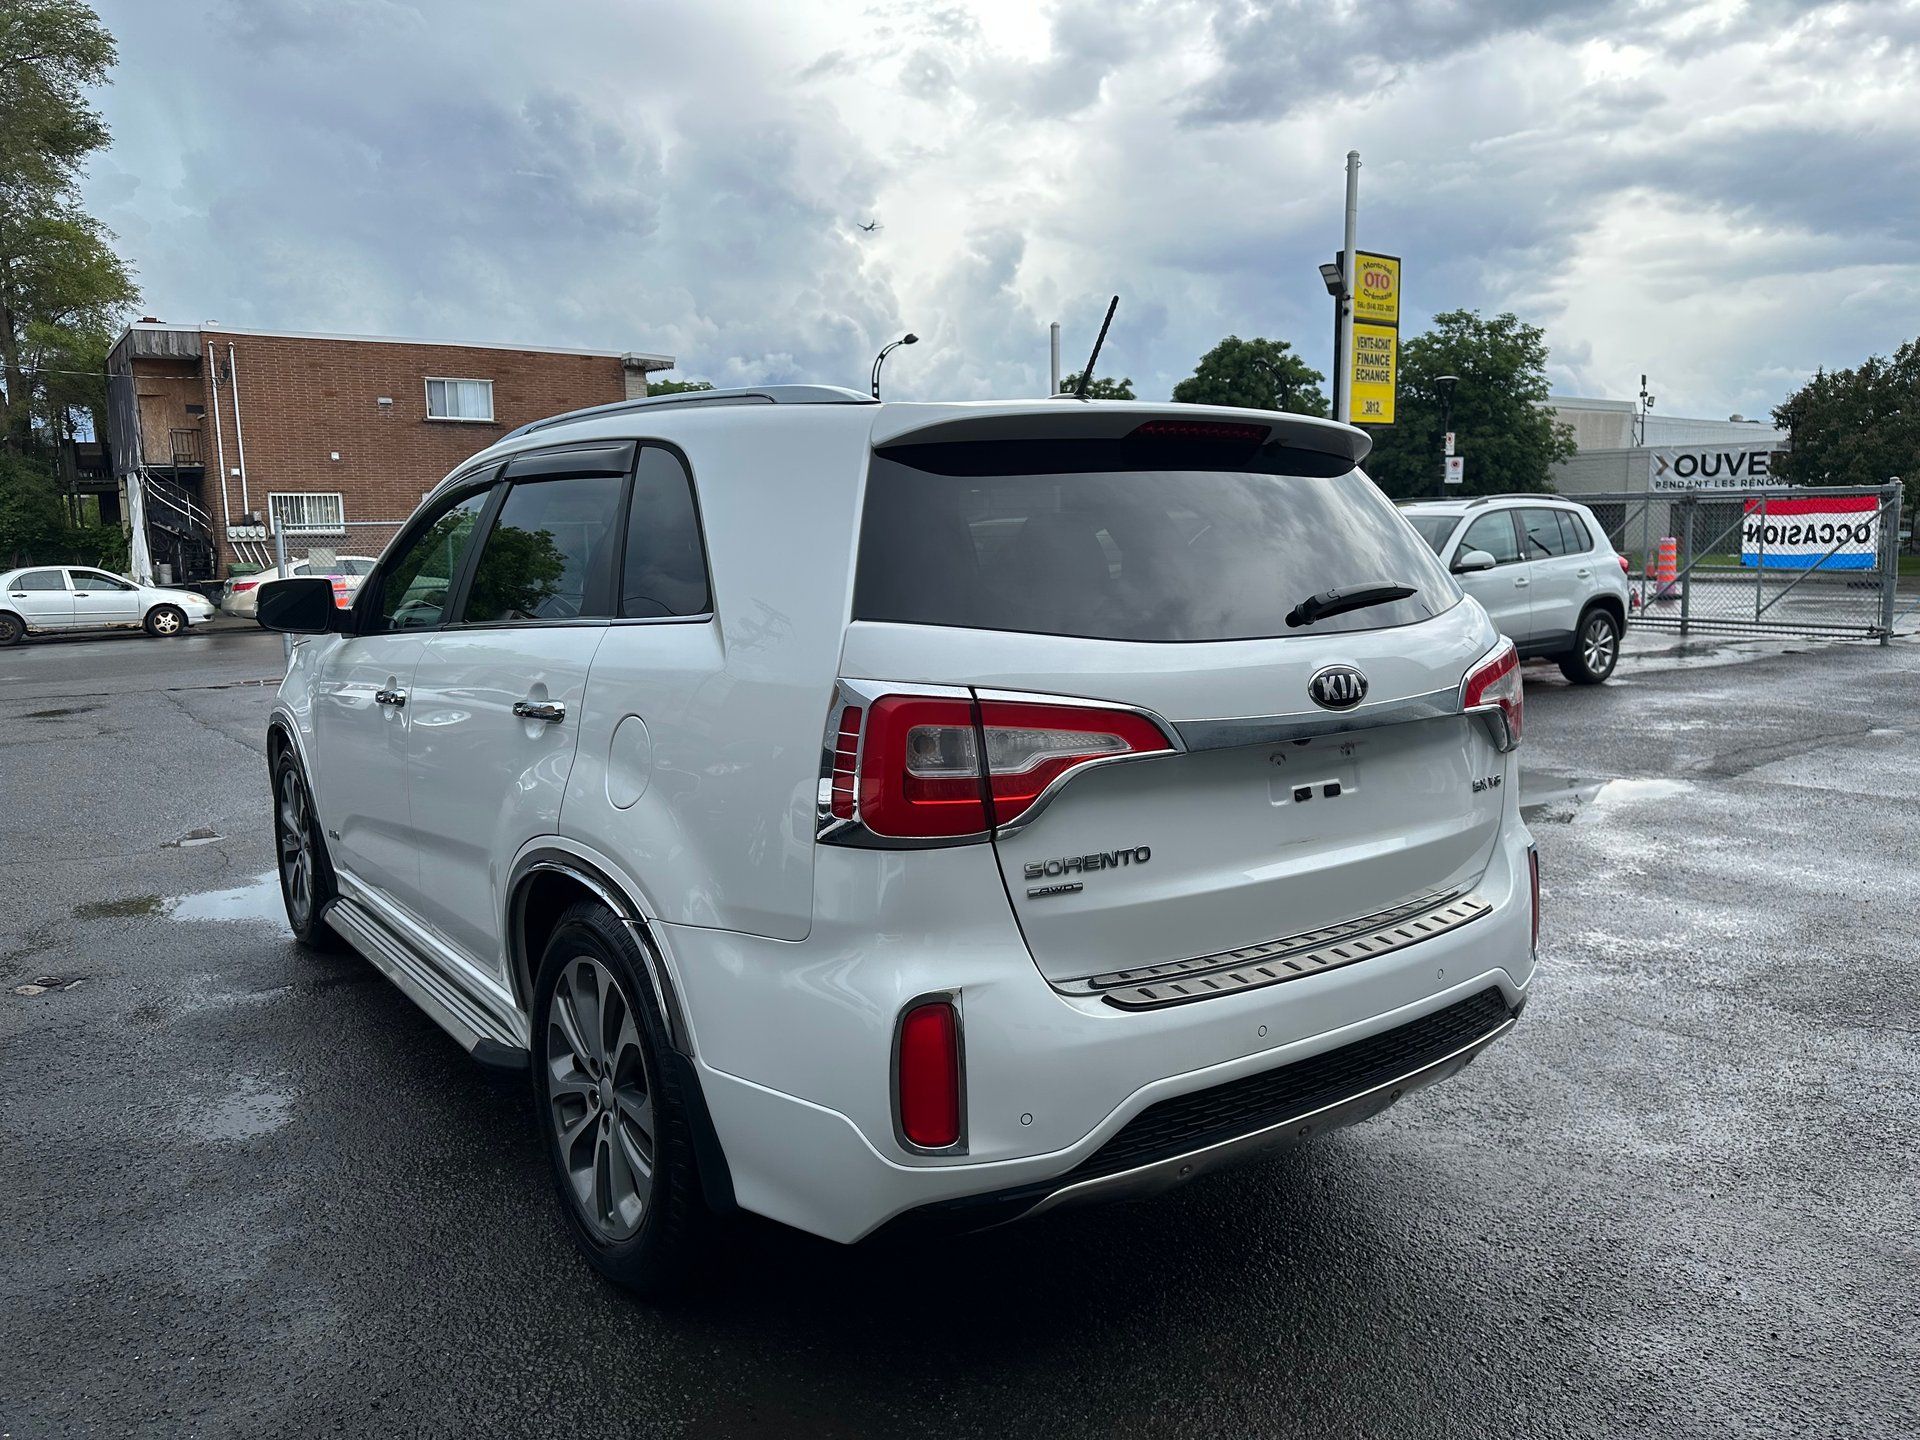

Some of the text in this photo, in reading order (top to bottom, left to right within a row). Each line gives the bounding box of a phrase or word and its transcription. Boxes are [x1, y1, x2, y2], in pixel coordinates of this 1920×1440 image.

[1365, 271, 1390, 289] OTO
[1357, 336, 1391, 350] VENTE-ACHAT
[1357, 352, 1390, 366] FINANCE
[1356, 369, 1390, 382] ECHANGE
[1365, 400, 1380, 413] 3812
[1655, 480, 1710, 489] PENDANT
[1715, 479, 1736, 488] LES
[1319, 673, 1363, 701] KIA
[1023, 846, 1152, 880] SORENTO
[1036, 883, 1077, 896] AWD
